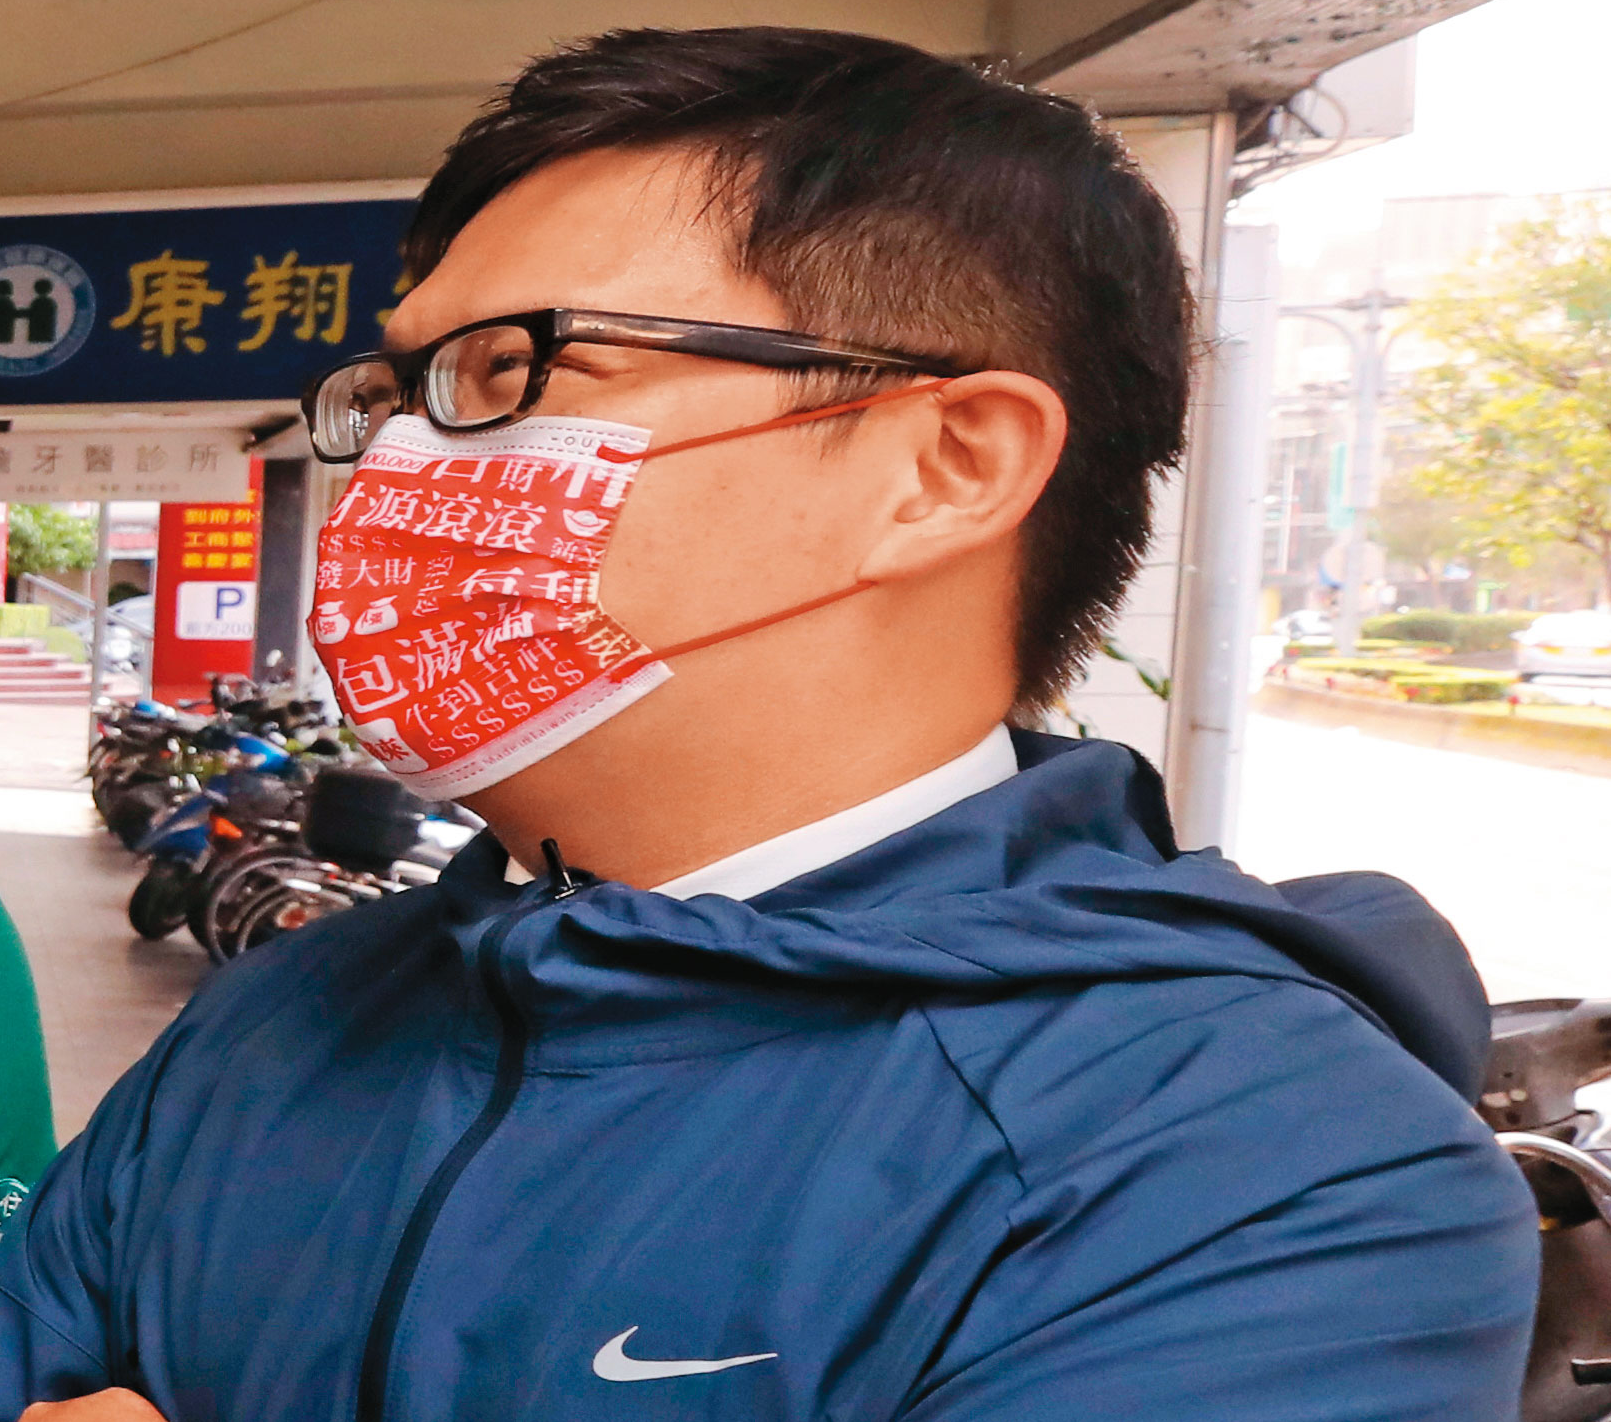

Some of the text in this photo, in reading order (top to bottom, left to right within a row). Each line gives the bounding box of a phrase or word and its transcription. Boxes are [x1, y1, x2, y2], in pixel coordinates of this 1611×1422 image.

[110, 250, 414, 357] 康翔
[317, 556, 417, 590] 發大財
[217, 587, 244, 619] P
